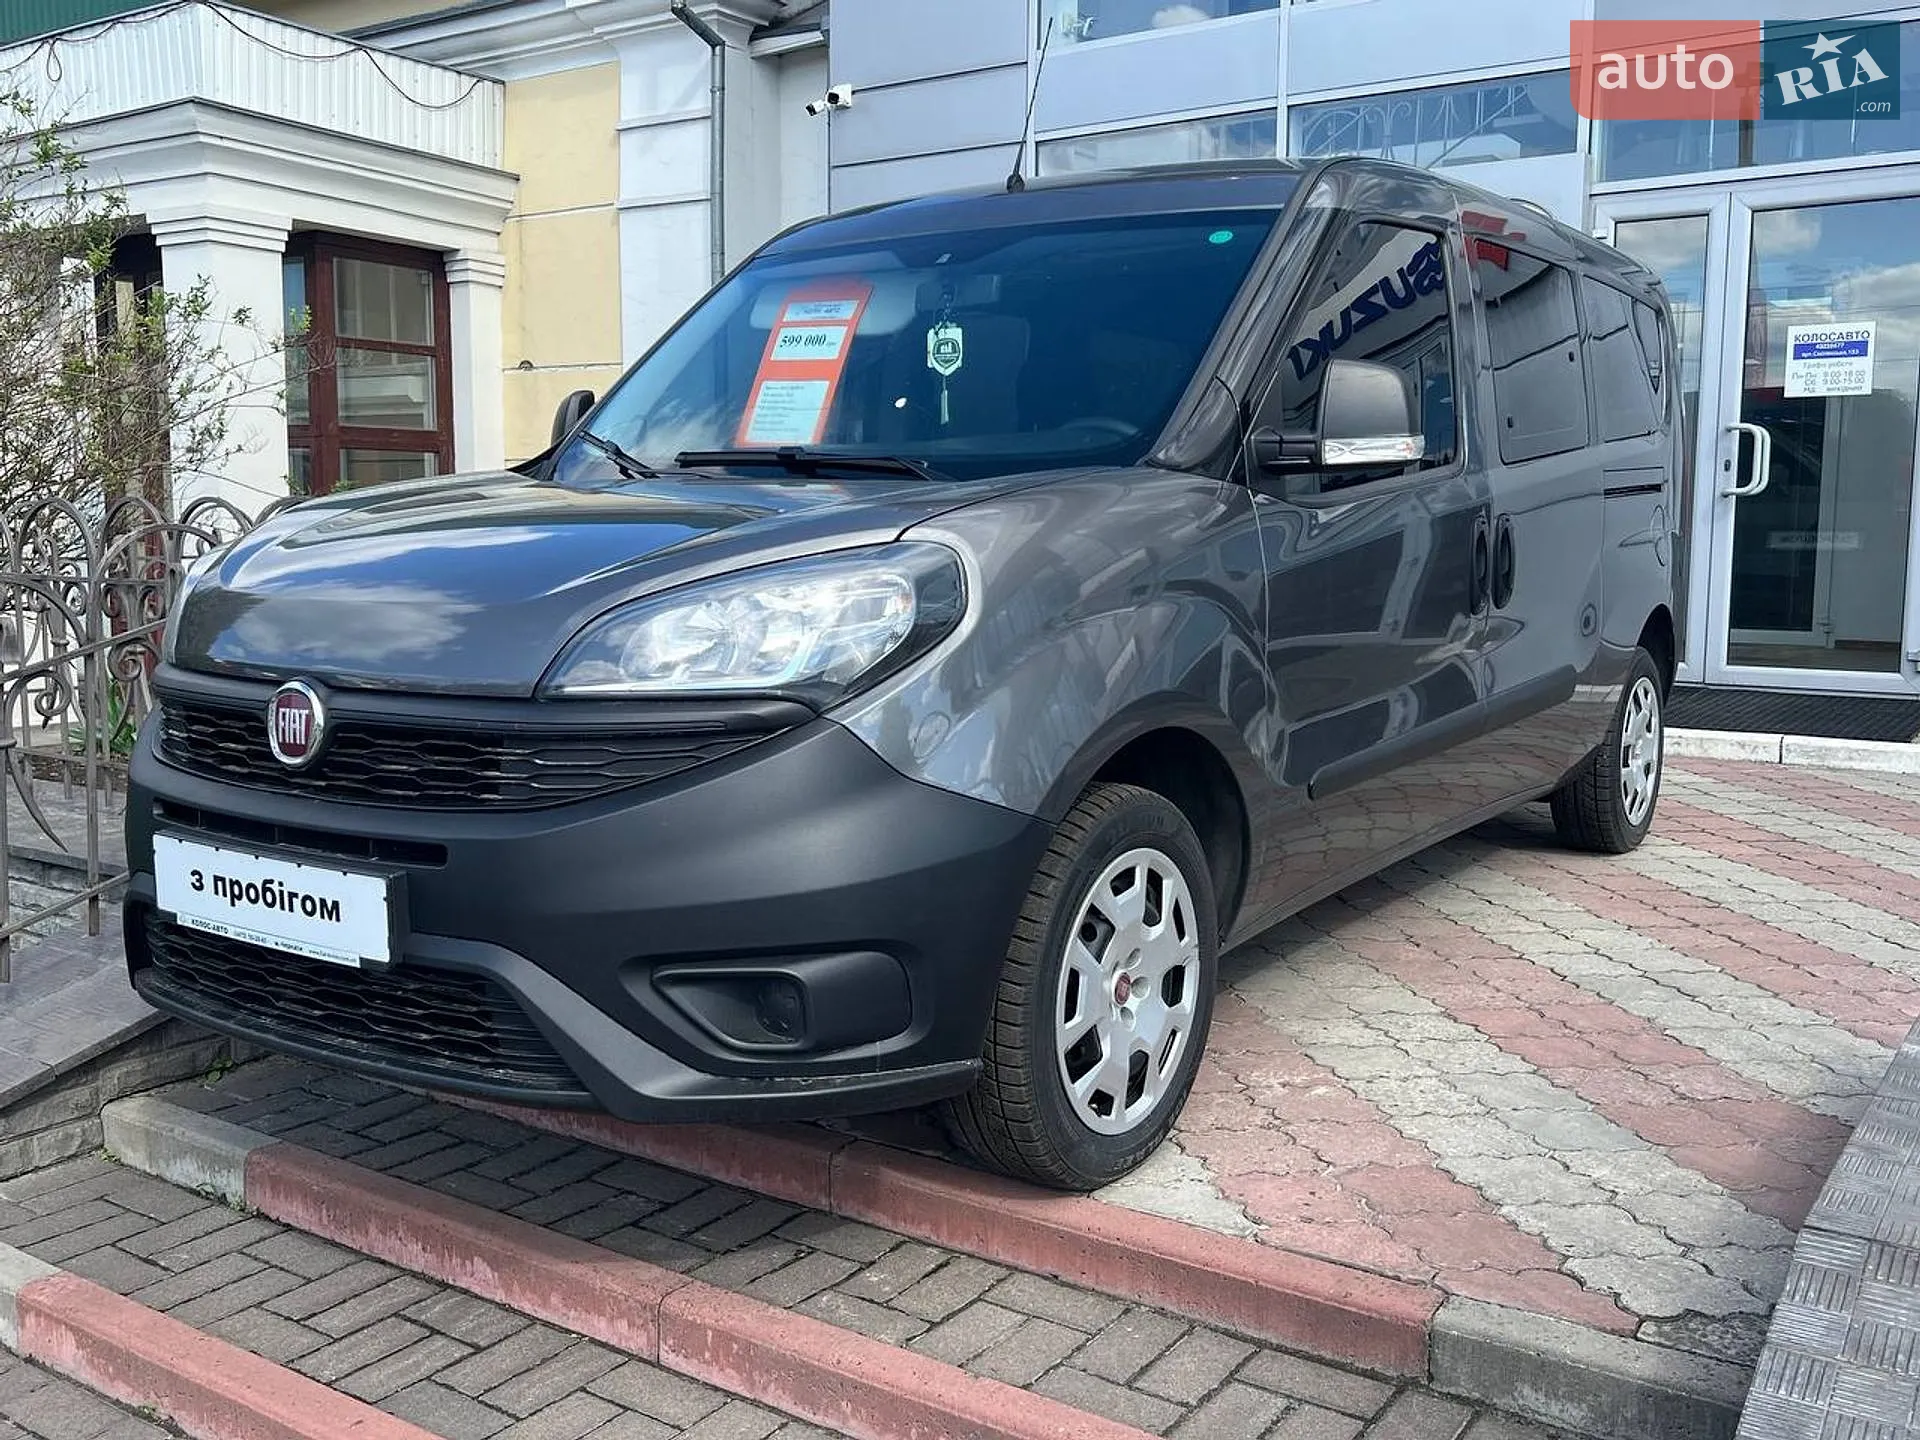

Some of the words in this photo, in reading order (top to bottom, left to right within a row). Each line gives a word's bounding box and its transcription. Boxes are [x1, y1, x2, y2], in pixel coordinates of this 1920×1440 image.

[780, 335, 802, 348] 599
[804, 334, 827, 348] 000
[1794, 330, 1870, 343] КОЛОСАВТО
[279, 708, 308, 744] FIAT
[190, 870, 205, 891] з
[212, 874, 341, 922] пробігом
